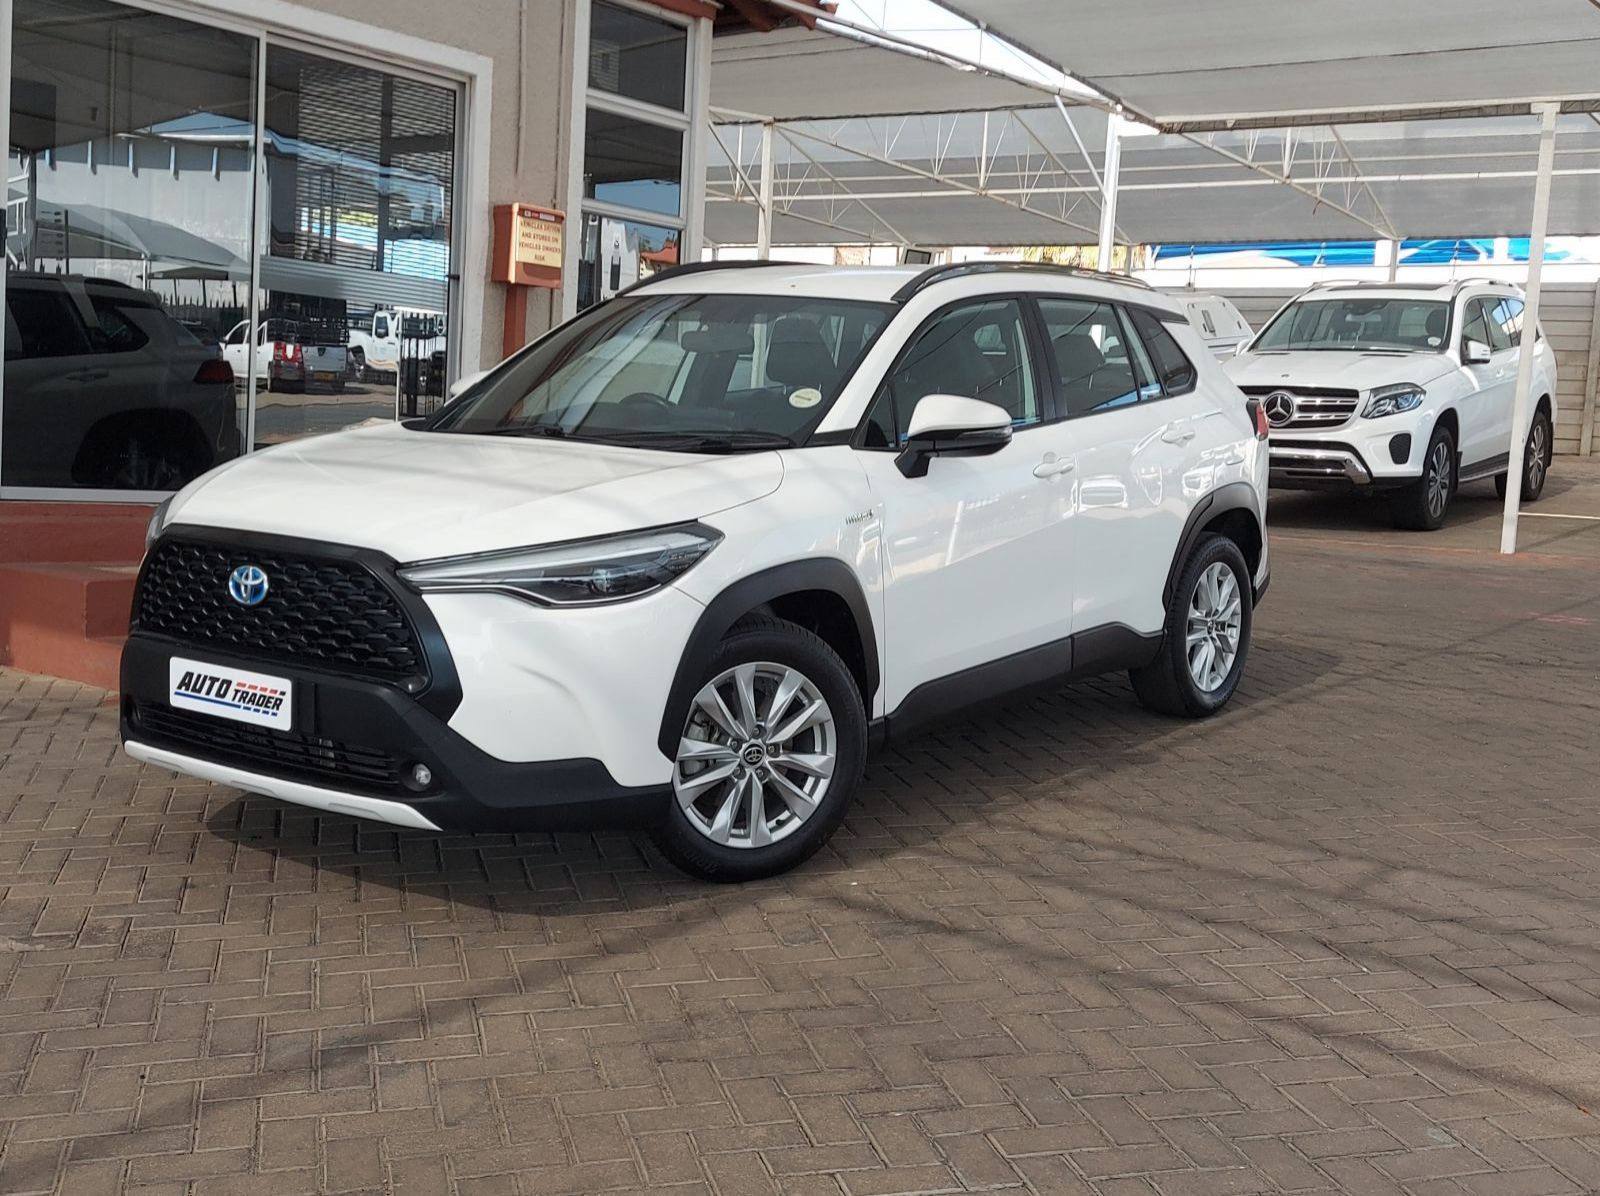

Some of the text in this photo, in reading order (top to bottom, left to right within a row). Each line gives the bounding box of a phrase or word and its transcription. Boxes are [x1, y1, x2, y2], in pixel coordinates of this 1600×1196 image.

[522, 231, 532, 239] AND
[519, 241, 541, 250] VEHICLES
[534, 253, 545, 261] RISK
[176, 671, 283, 711] AUTO TRADER
